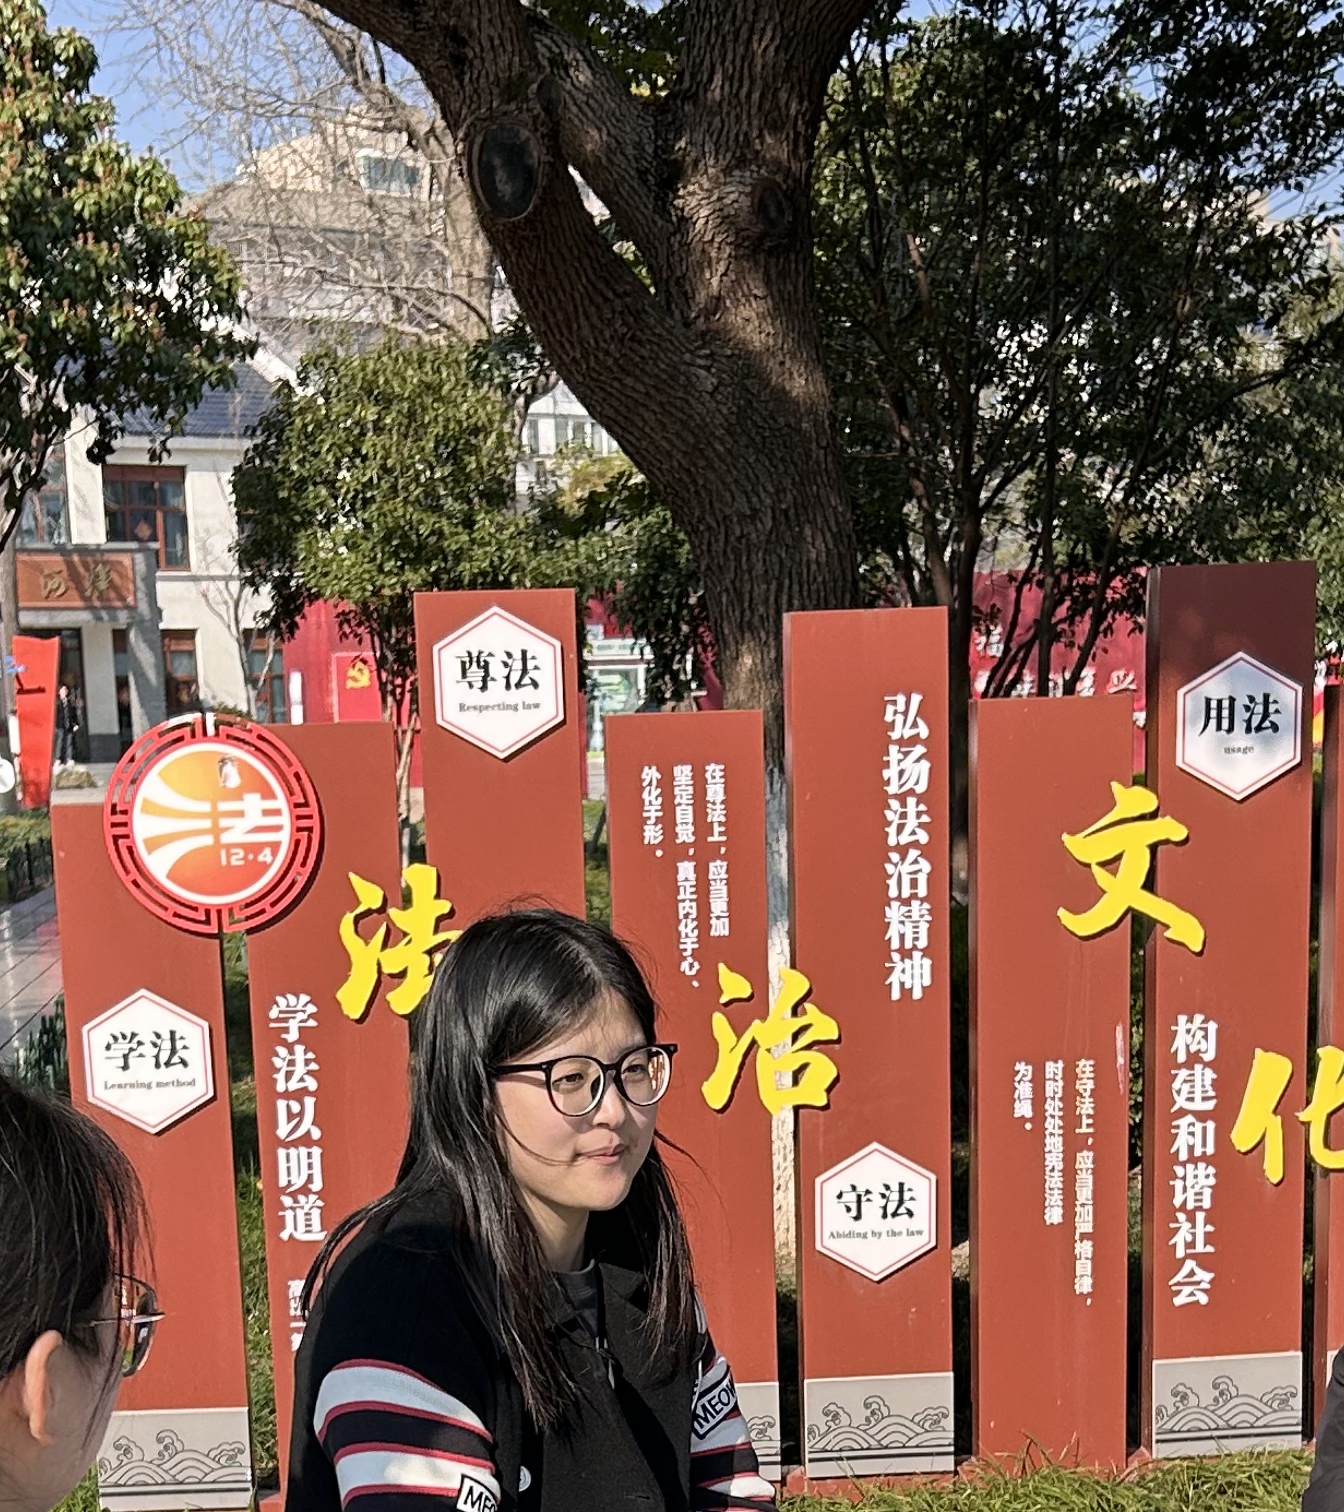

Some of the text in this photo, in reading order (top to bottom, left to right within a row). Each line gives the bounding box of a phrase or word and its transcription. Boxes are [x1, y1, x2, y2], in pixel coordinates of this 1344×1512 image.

[456, 648, 541, 693] 尊法
[459, 701, 541, 713] Respecting law
[1198, 692, 1283, 736] 用法
[883, 692, 933, 1000] 弘扬法治精神
[701, 963, 839, 1116] 治
[1057, 781, 1205, 953] 文
[104, 1029, 190, 1072] 学法
[104, 1077, 196, 1091] Learning method
[268, 993, 328, 1242] 学法以明道
[1168, 1013, 1219, 1307] 构建和谐社会
[835, 1181, 917, 1223] 守法
[828, 1228, 924, 1239] Abiding by the law
